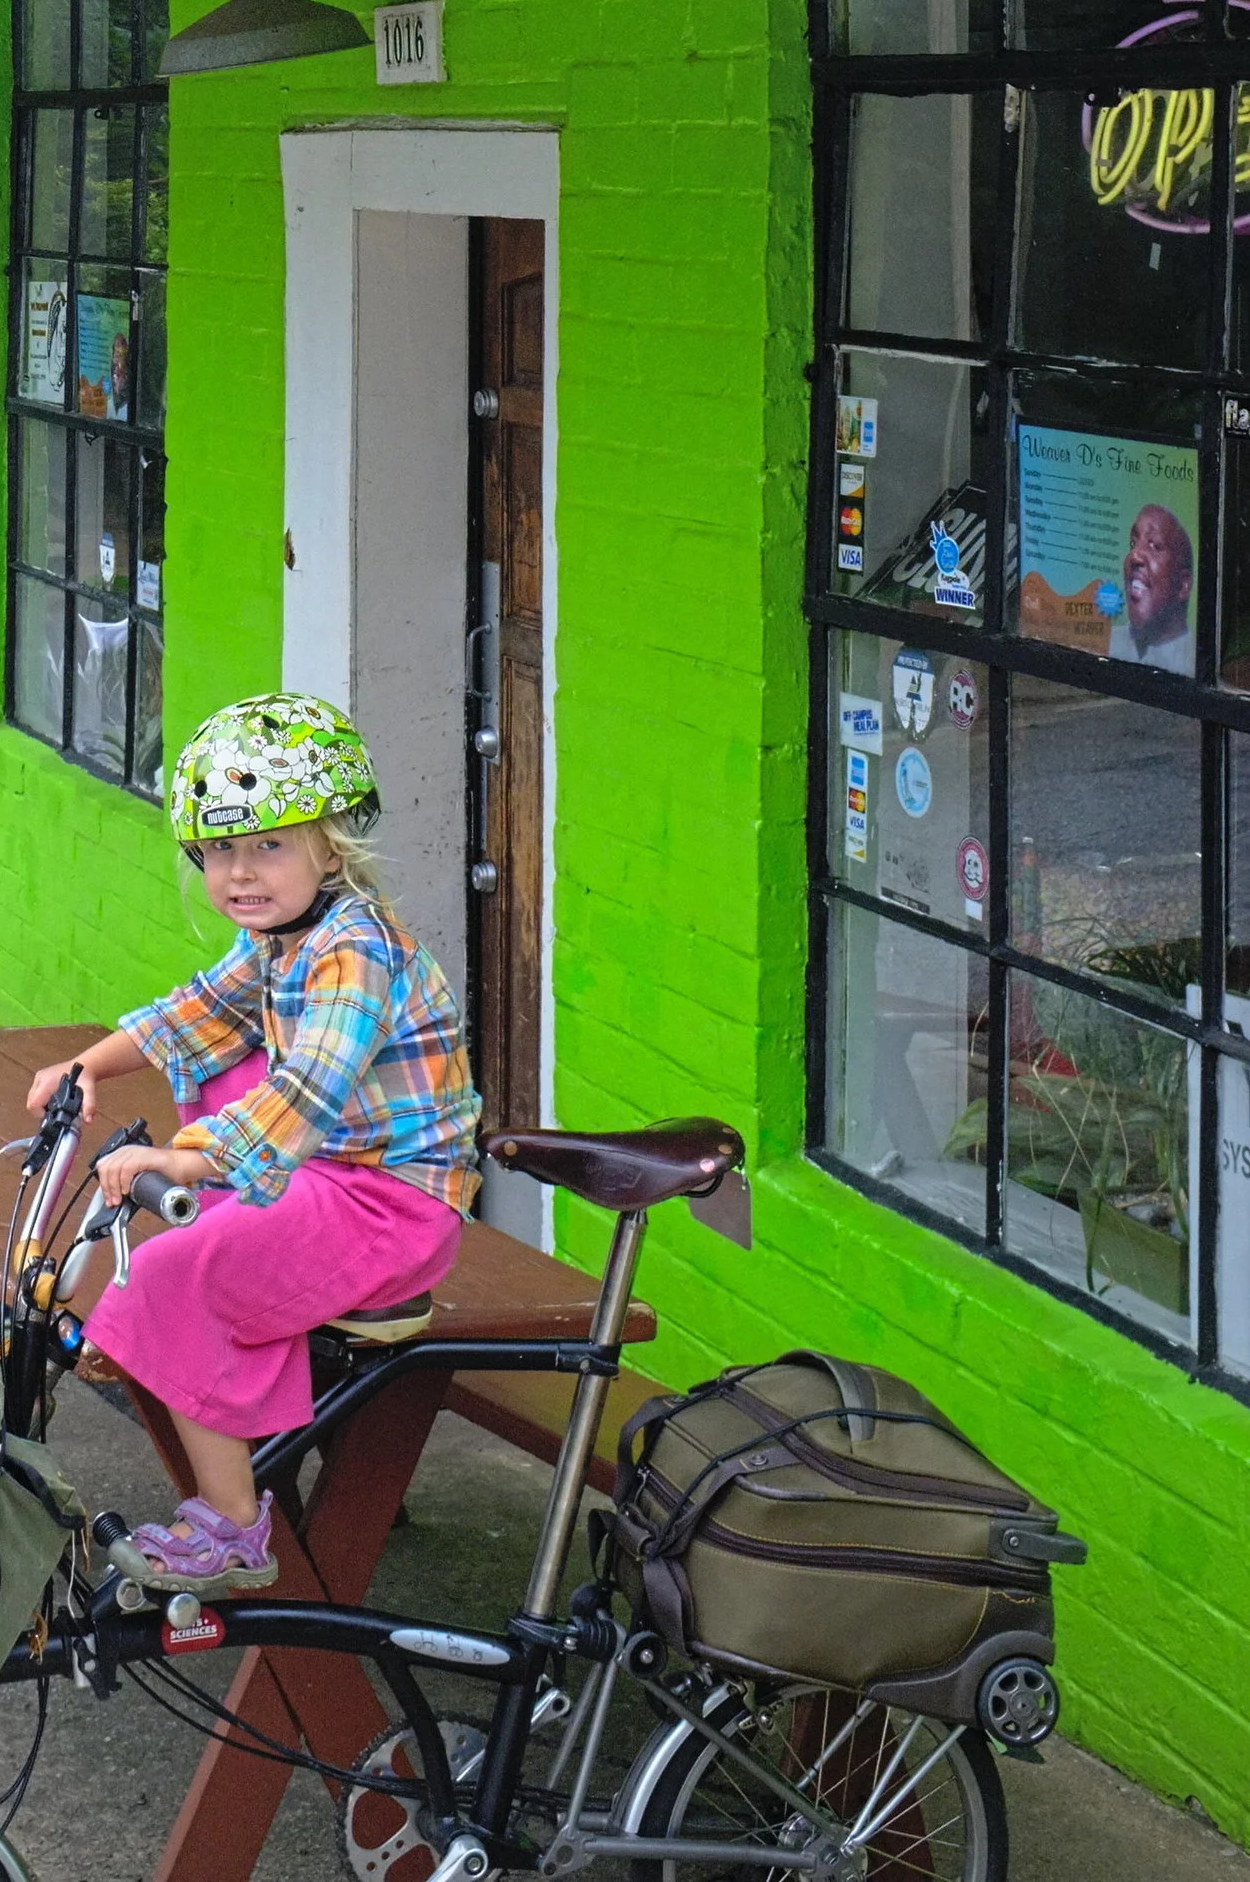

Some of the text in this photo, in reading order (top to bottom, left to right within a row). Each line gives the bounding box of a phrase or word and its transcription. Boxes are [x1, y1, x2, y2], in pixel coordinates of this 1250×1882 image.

[383, 16, 424, 66] 1016
[1021, 434, 1194, 483] Weaver D's Fine Foods
[841, 549, 861, 565] VISA
[936, 588, 974, 607] WINNER
[866, 720, 879, 731] PLAN
[207, 808, 244, 824] nutcase
[850, 818, 865, 829] VISA
[170, 1625, 217, 1639] SCIENCES
